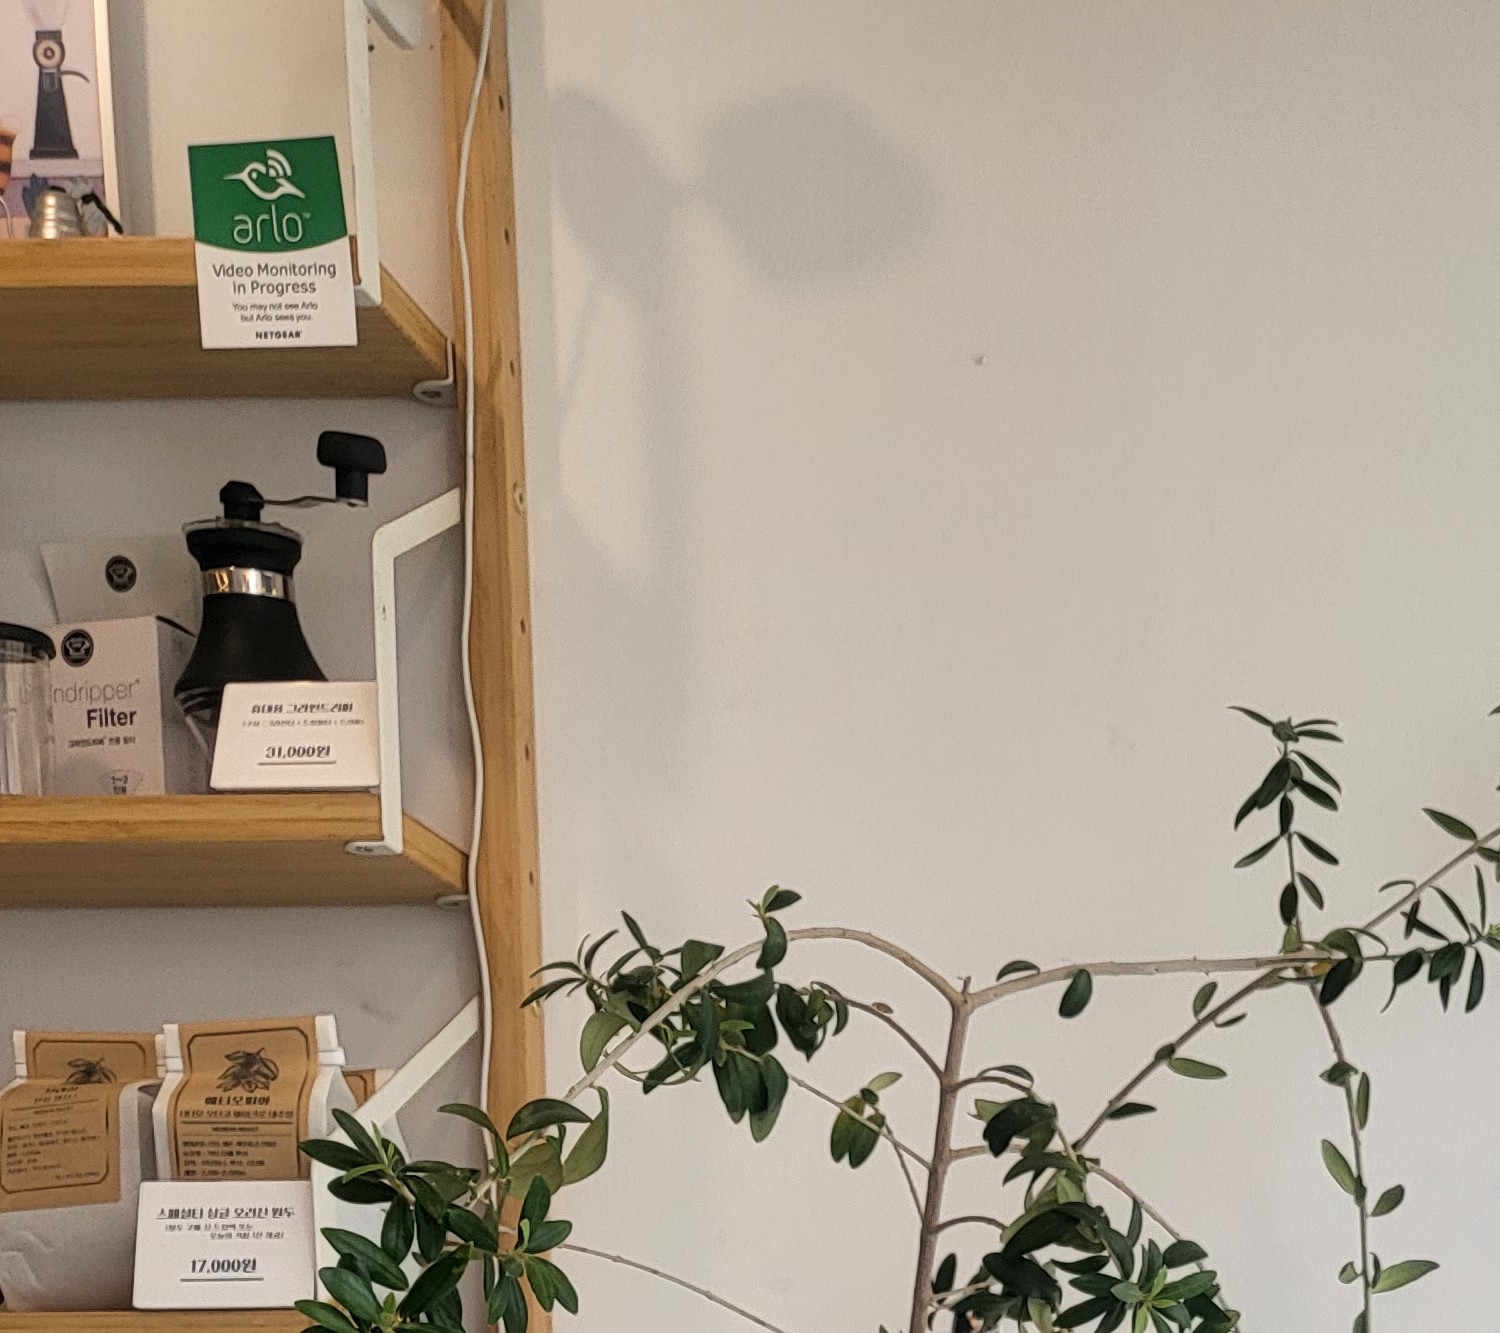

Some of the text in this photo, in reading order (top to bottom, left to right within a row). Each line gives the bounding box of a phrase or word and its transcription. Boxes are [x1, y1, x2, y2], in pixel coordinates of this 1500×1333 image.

[233, 203, 303, 244] arlo
[212, 262, 337, 278] Video Monitoring
[251, 281, 317, 297] Progress
[232, 302, 248, 312] You
[250, 303, 268, 312] may
[269, 302, 282, 311] not
[301, 301, 318, 310] Arlo
[256, 313, 273, 322] Arlo
[255, 331, 301, 340] NETGEAR
[86, 707, 137, 729] Filter
[265, 745, 331, 759] 31,000원
[156, 1206, 296, 1220] 스페셜티 싱글 오리진 원두
[191, 1258, 257, 1274] 17,000원
